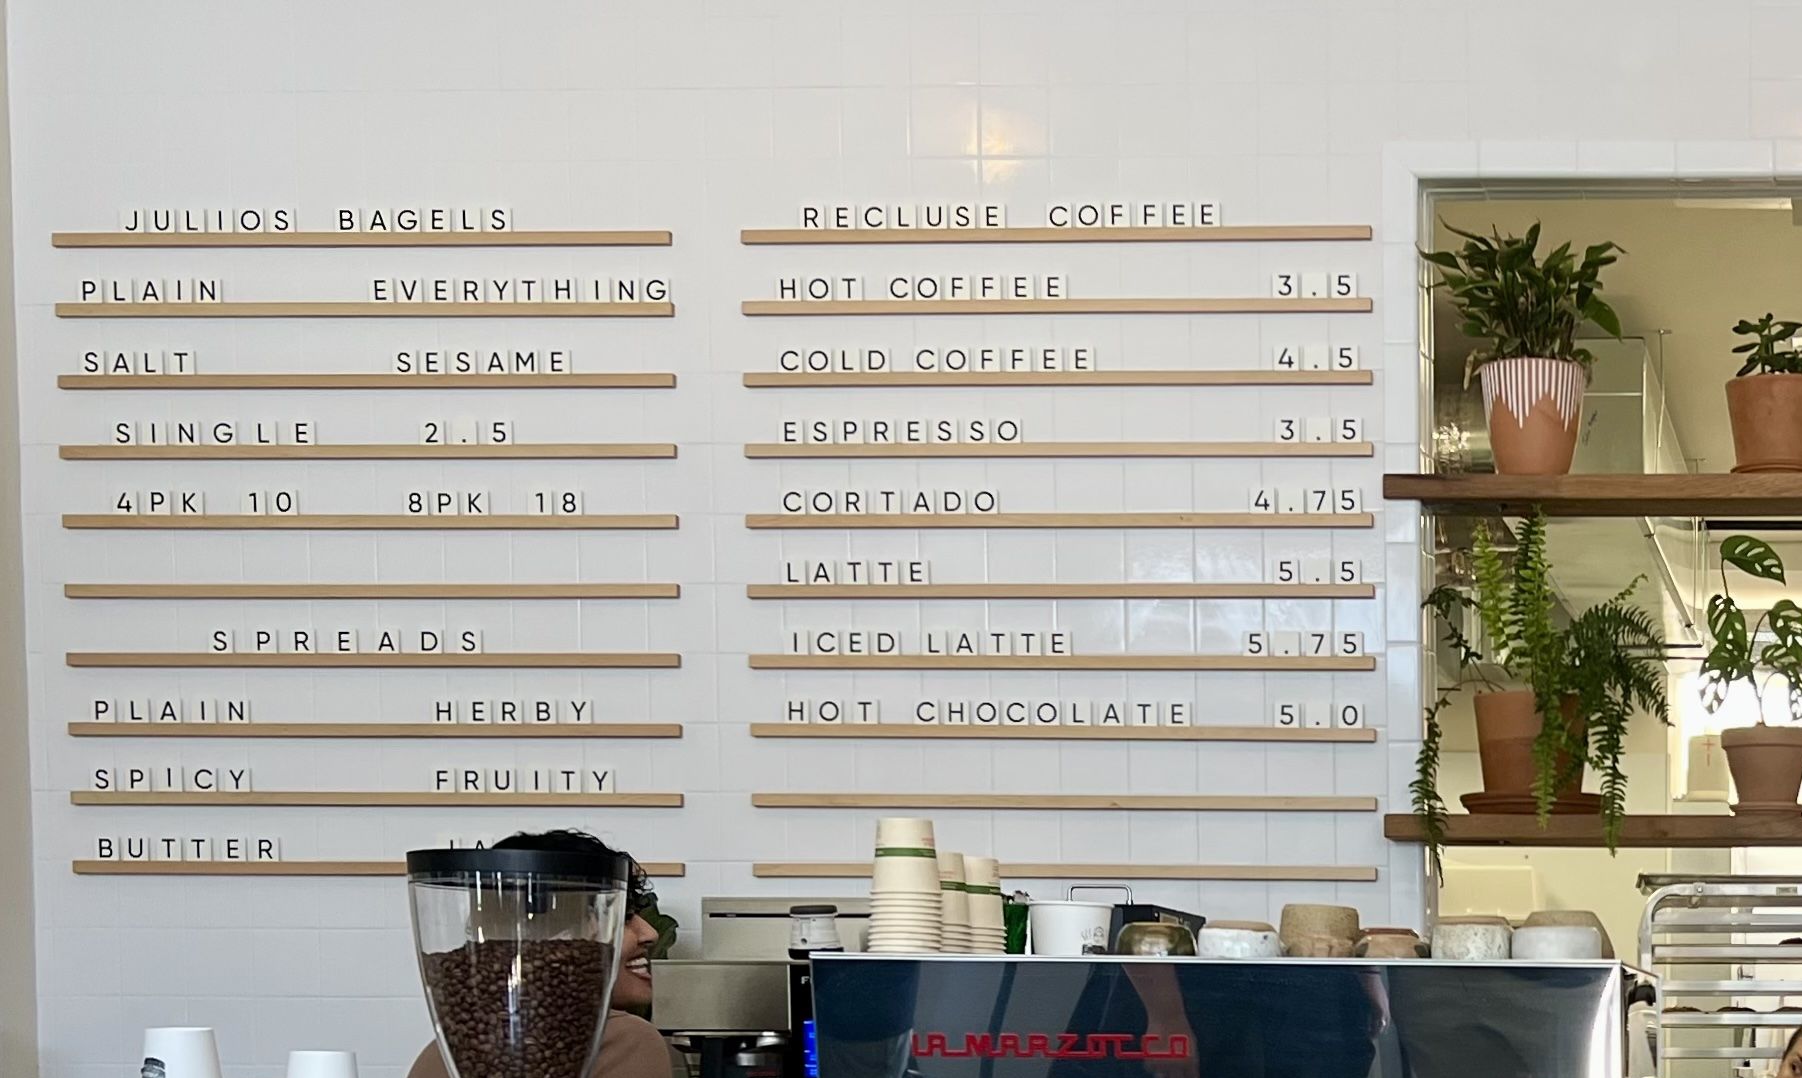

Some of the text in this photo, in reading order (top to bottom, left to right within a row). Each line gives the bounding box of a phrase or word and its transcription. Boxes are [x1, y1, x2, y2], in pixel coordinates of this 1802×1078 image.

[125, 209, 506, 231] JULIOS BAGELS
[803, 204, 1213, 228] RECLUSE COFFEE
[82, 279, 666, 302] PLAIN EVERYTHING
[780, 275, 1351, 299] HOT COFFEE 3.5
[84, 351, 563, 373] SALT SESAME
[780, 347, 1353, 371] COLD COFFEE 4.5
[116, 422, 506, 444] SINGLE 2.5
[784, 419, 1356, 442] ESPRESSO 3.5
[116, 491, 577, 514] 4PK 10 8PK 18
[783, 489, 1355, 513] CORTADO 4.75
[787, 561, 1355, 583] LATTE 5.5
[213, 630, 476, 652] SPREADS
[793, 632, 1357, 655] ICED LATTE 5.75
[94, 700, 586, 722] PLAIN HERBY
[788, 701, 1358, 726] HOT CHOCOLATE 5.0
[95, 767, 608, 791] SPICY FRUITY
[98, 837, 273, 860] BUTTER
